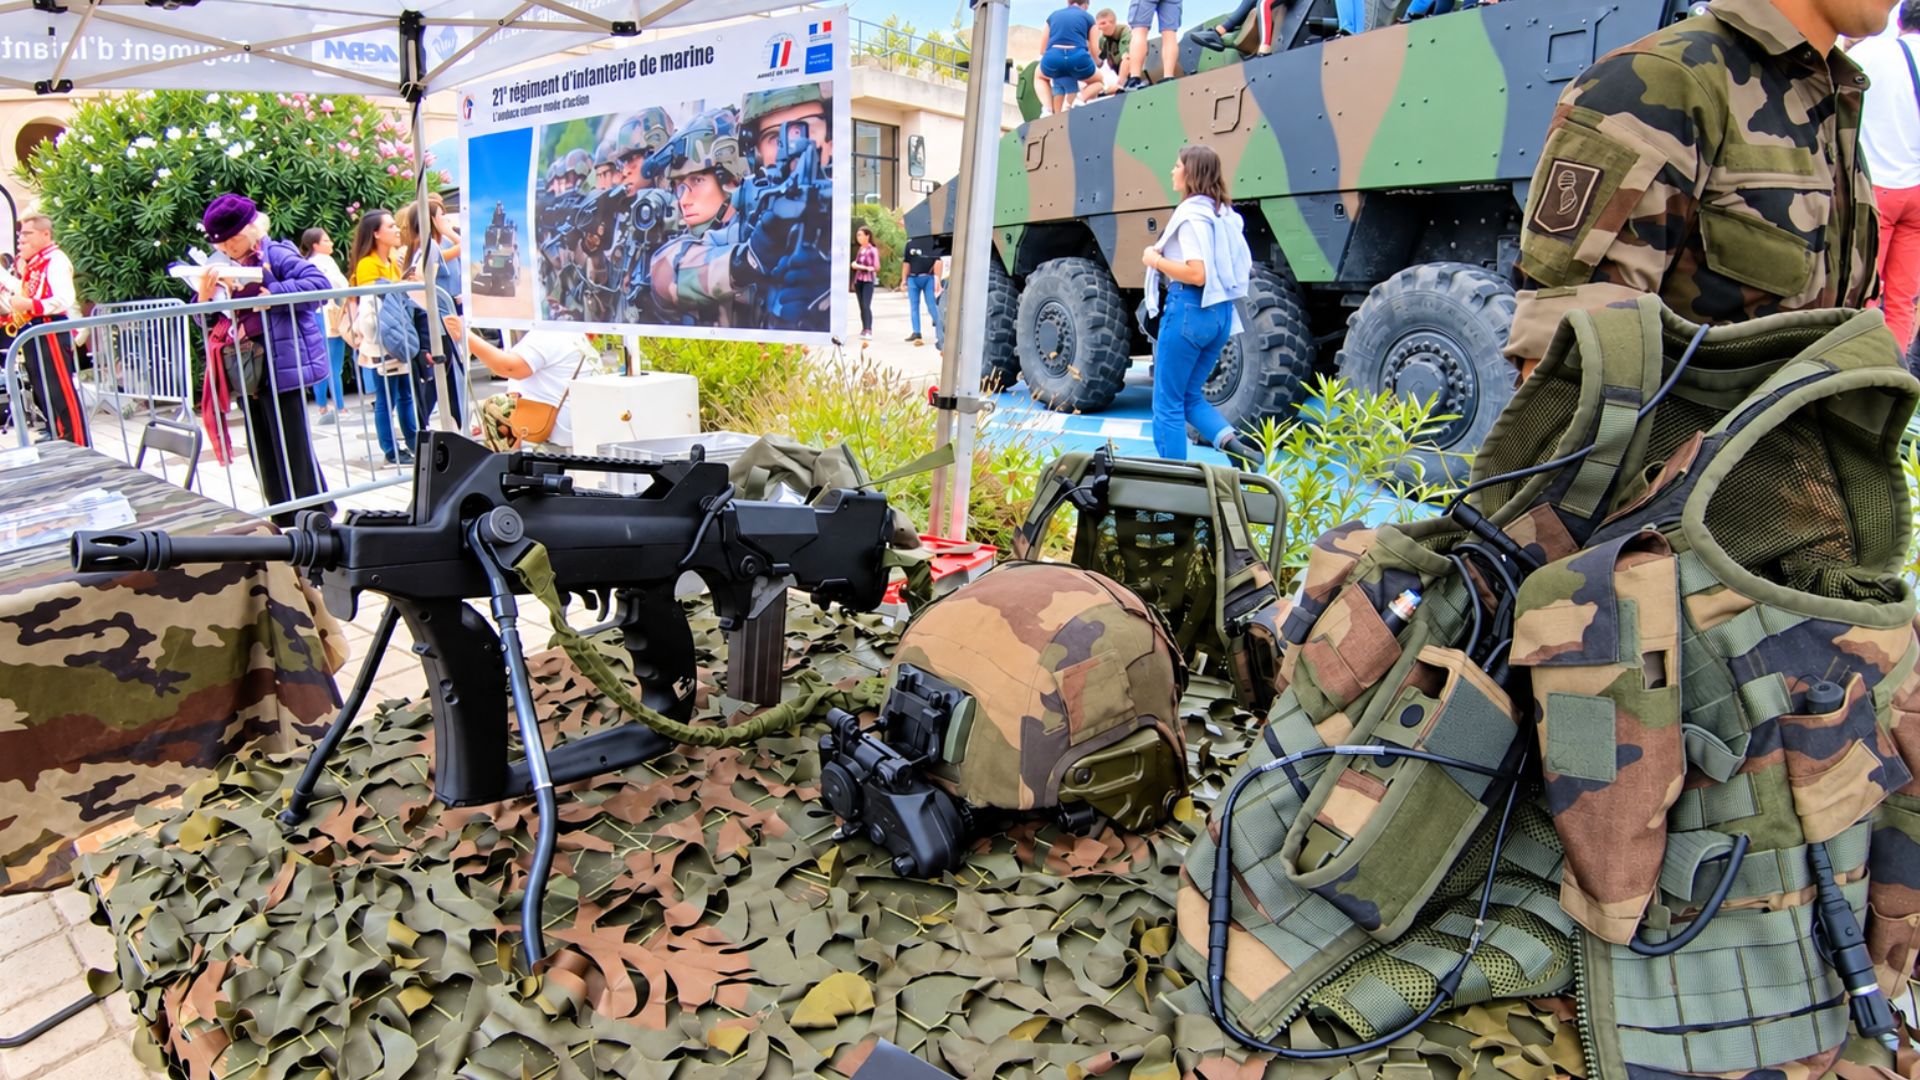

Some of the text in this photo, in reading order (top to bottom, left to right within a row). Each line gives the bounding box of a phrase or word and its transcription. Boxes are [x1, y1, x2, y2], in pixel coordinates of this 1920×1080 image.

[509, 75, 560, 104] régiment
[562, 58, 636, 92] d'infanterie
[640, 54, 657, 77] de
[660, 45, 714, 73] marine
